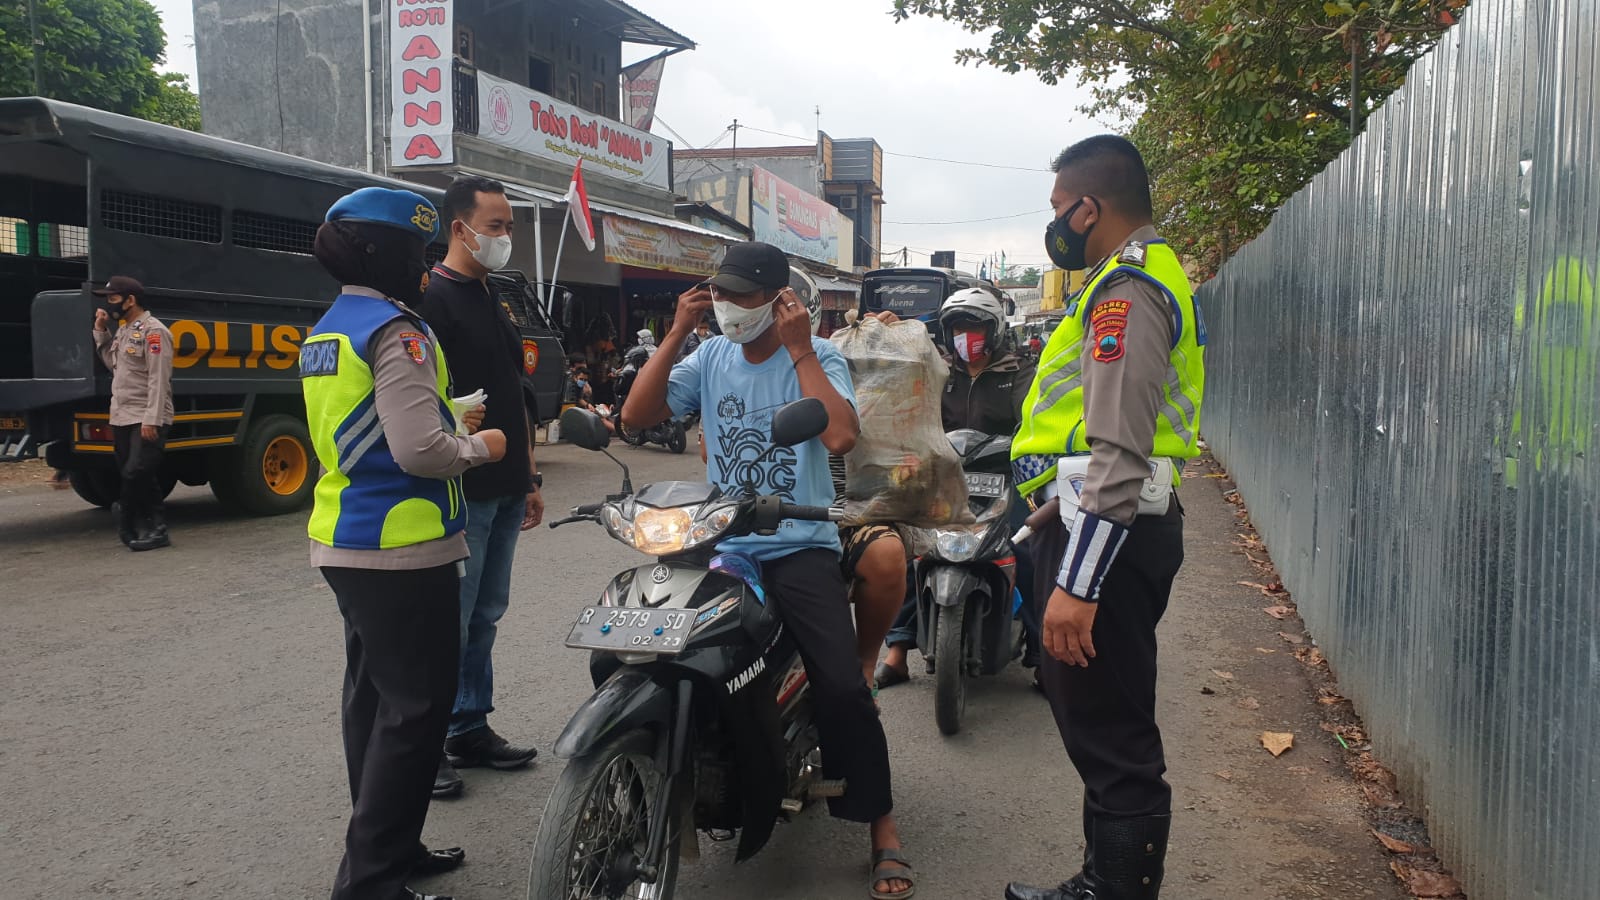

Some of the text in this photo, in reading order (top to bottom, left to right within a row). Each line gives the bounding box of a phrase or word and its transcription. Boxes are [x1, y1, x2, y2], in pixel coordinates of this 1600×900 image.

[399, 7, 446, 28] ROTI
[401, 34, 442, 161] ANNA
[530, 100, 568, 140] Toko
[570, 114, 599, 150] Roti
[1092, 301, 1128, 317] POLRES
[714, 454, 798, 491] YOG
[580, 608, 687, 630] R 2579 SD
[631, 635, 682, 647] 02 23
[726, 656, 766, 694] YAMAHA
